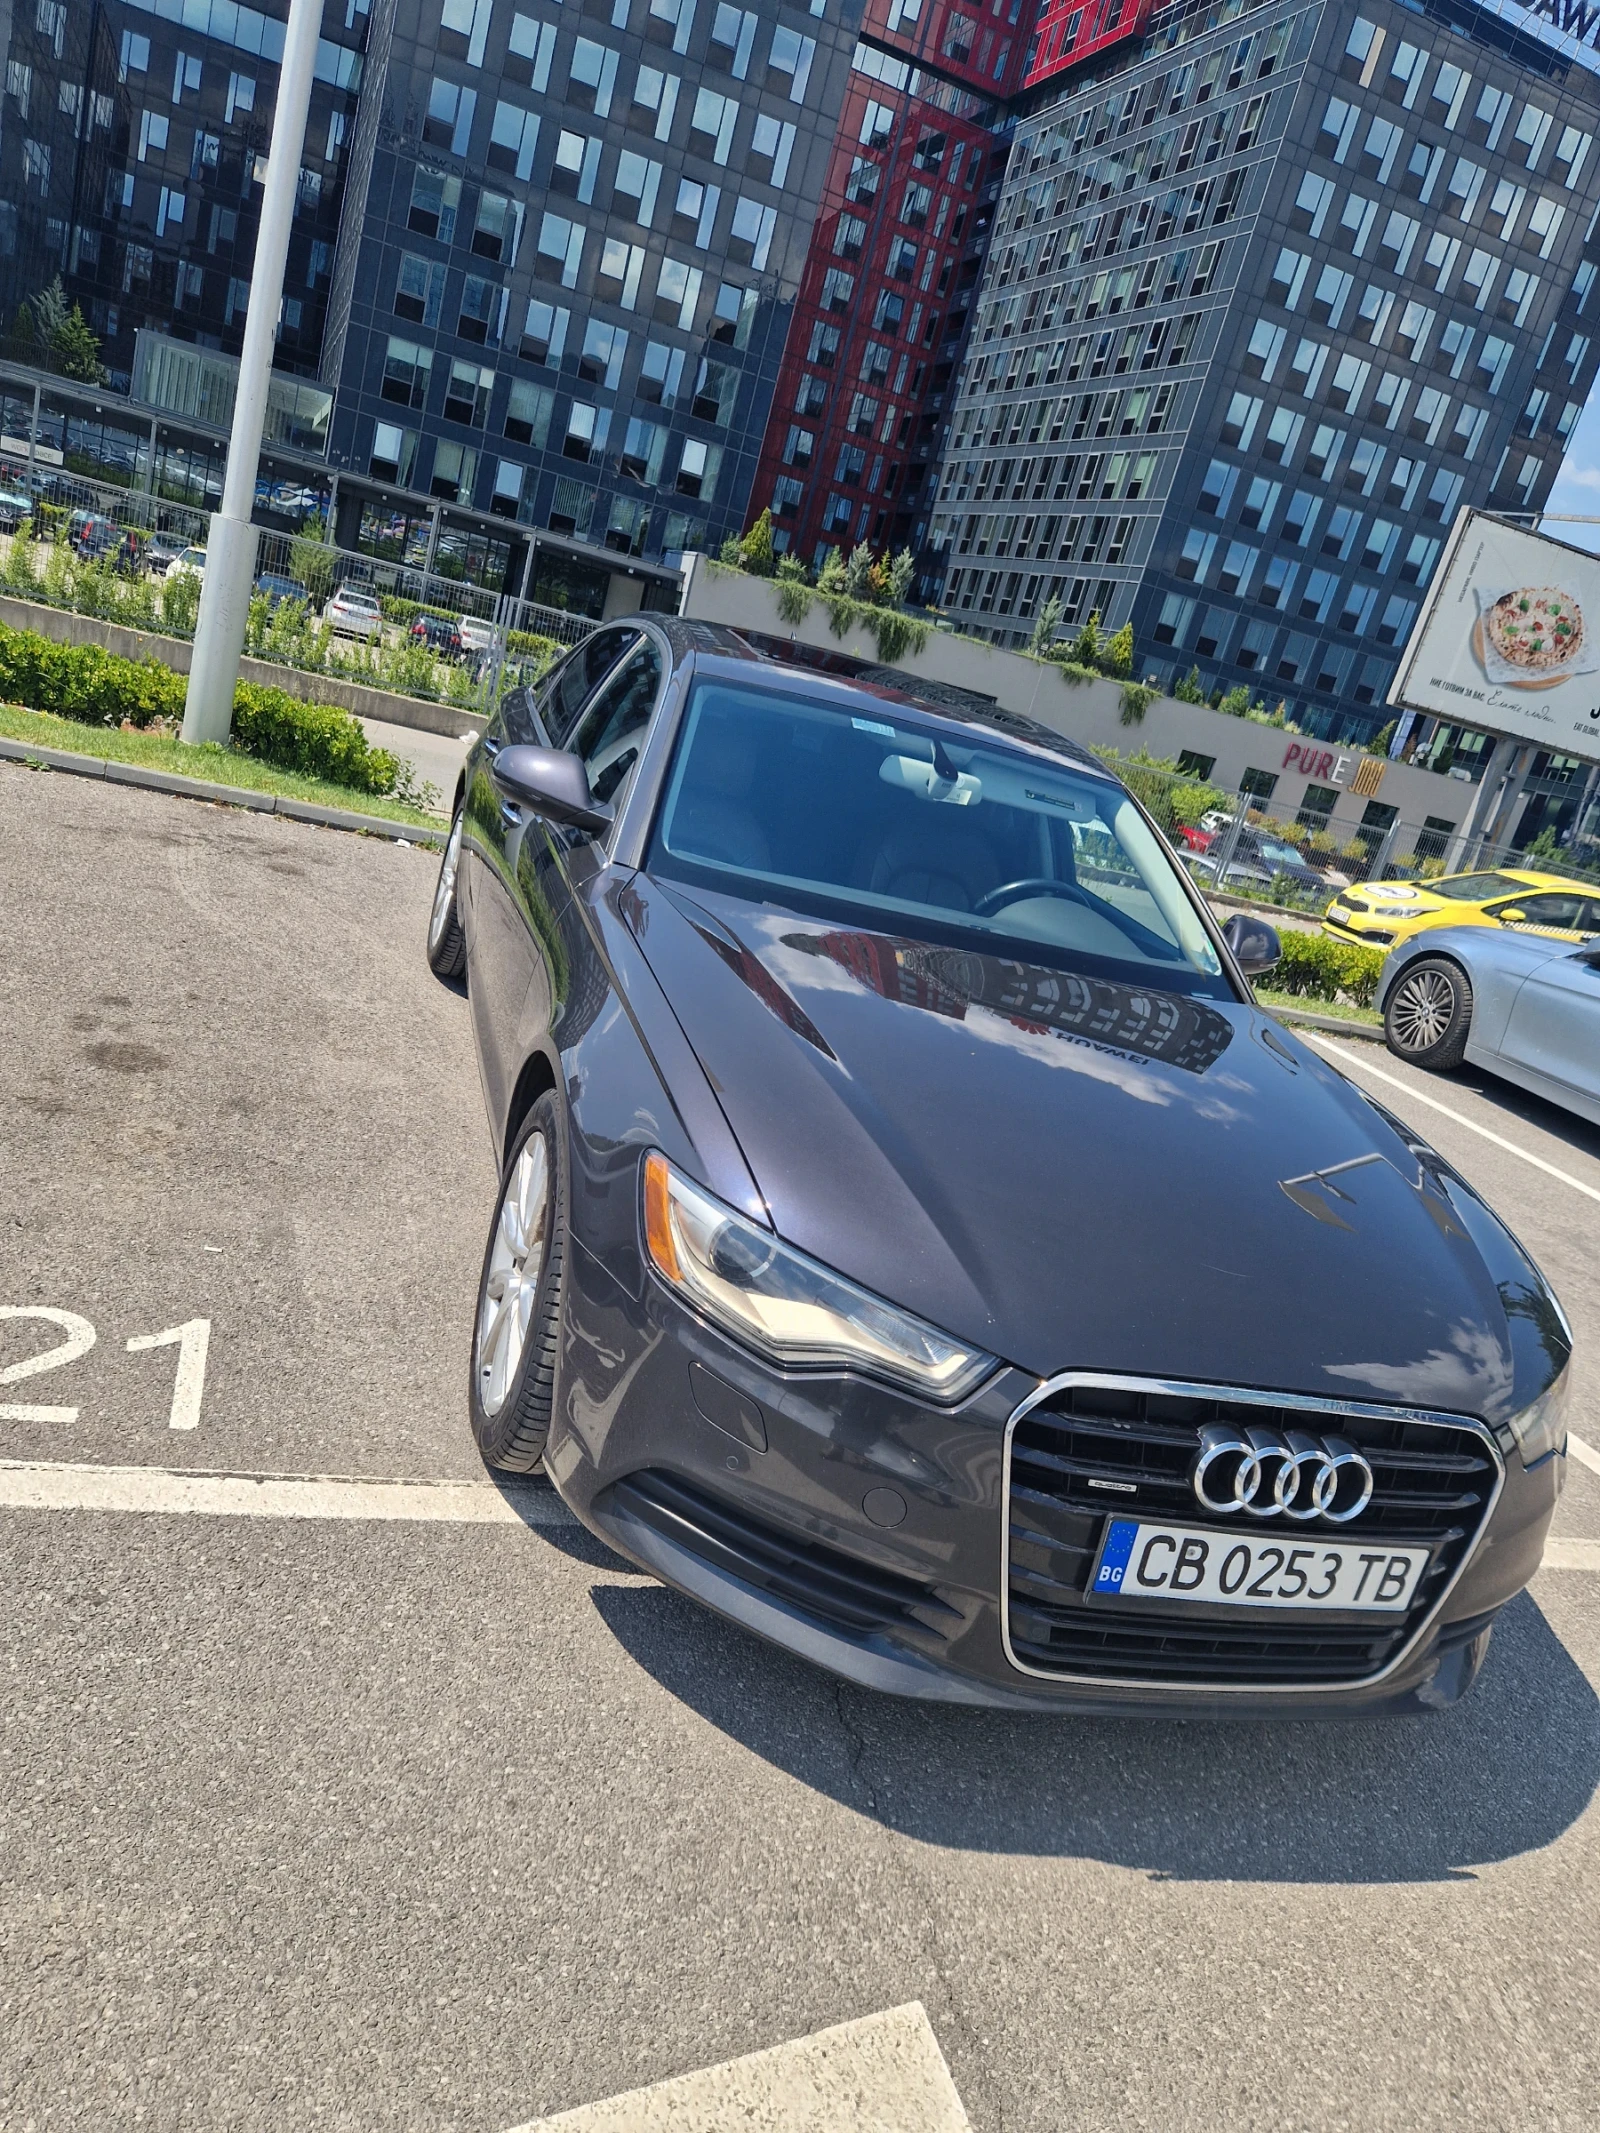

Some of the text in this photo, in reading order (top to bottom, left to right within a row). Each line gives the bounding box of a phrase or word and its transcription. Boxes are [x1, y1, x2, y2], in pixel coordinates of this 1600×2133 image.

[1282, 741, 1350, 784] PURE
[1099, 1566, 1123, 1582] BG
[1137, 1535, 1412, 1602] CB 0253 TB
